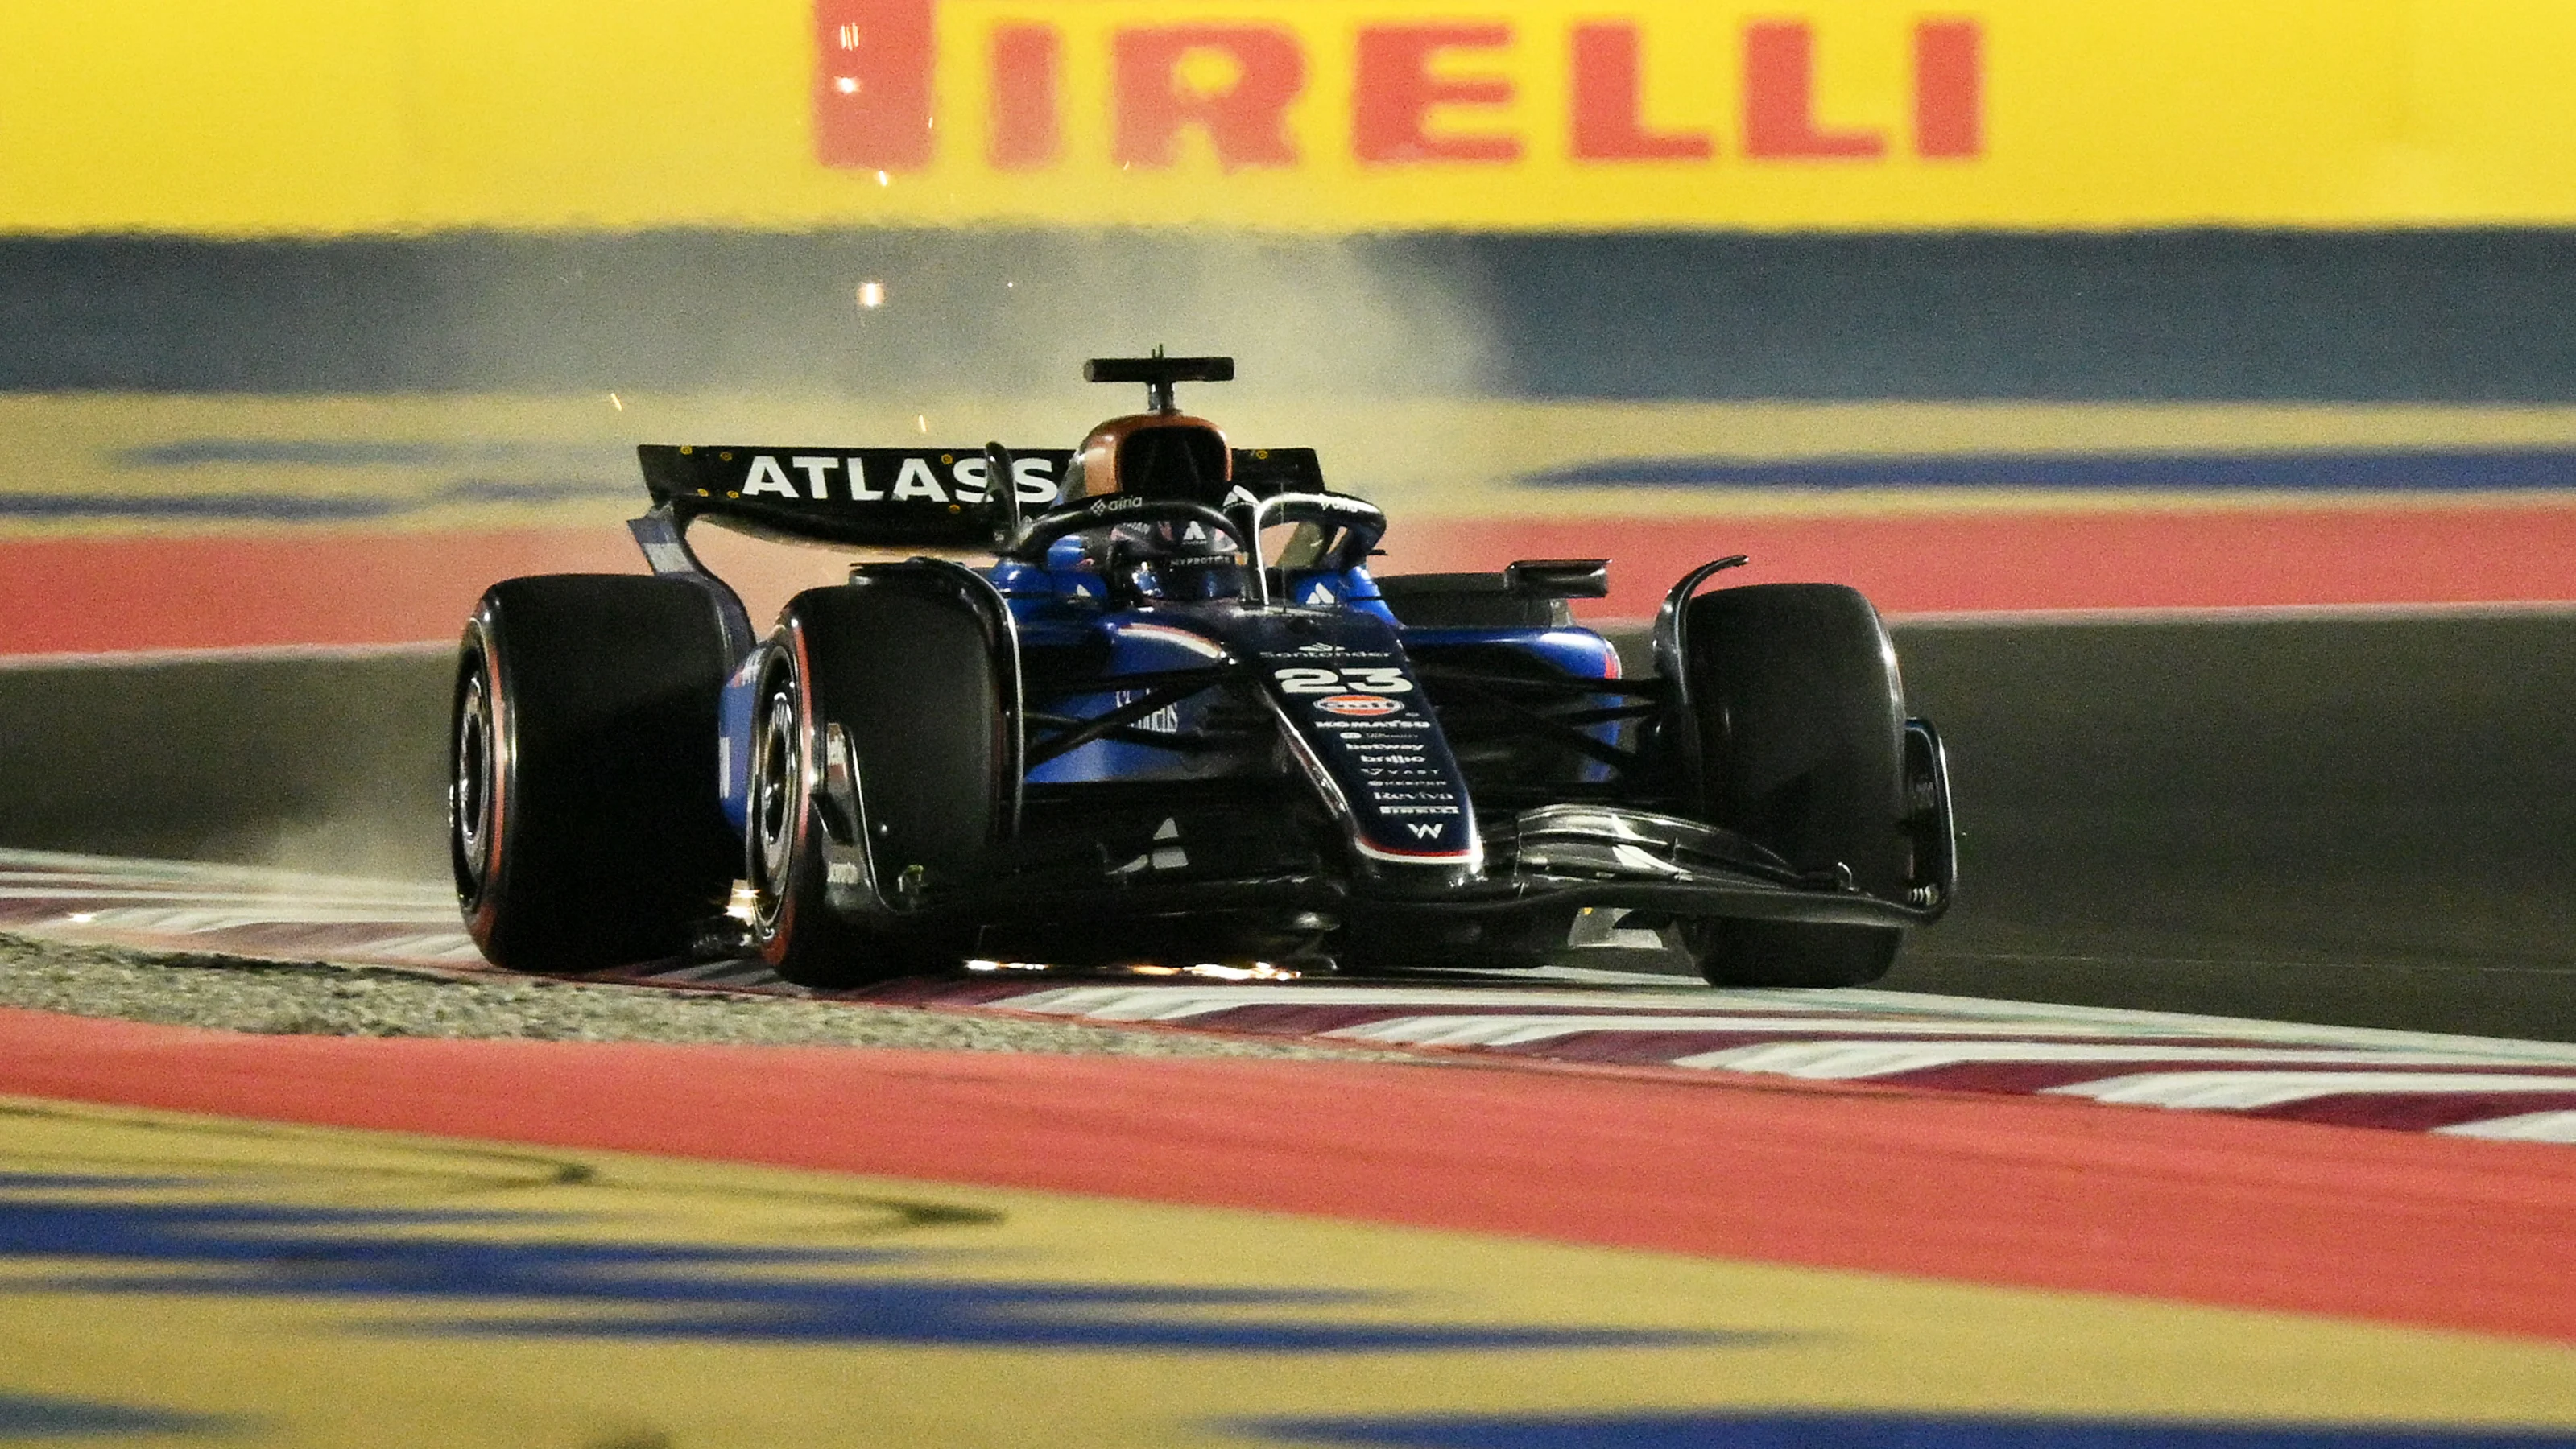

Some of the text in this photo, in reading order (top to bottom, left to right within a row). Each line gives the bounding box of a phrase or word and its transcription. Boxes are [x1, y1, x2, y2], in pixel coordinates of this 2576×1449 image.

[1107, 496, 1143, 511] airia
[1274, 667, 1413, 693] 23
[1346, 743, 1424, 751] betway
